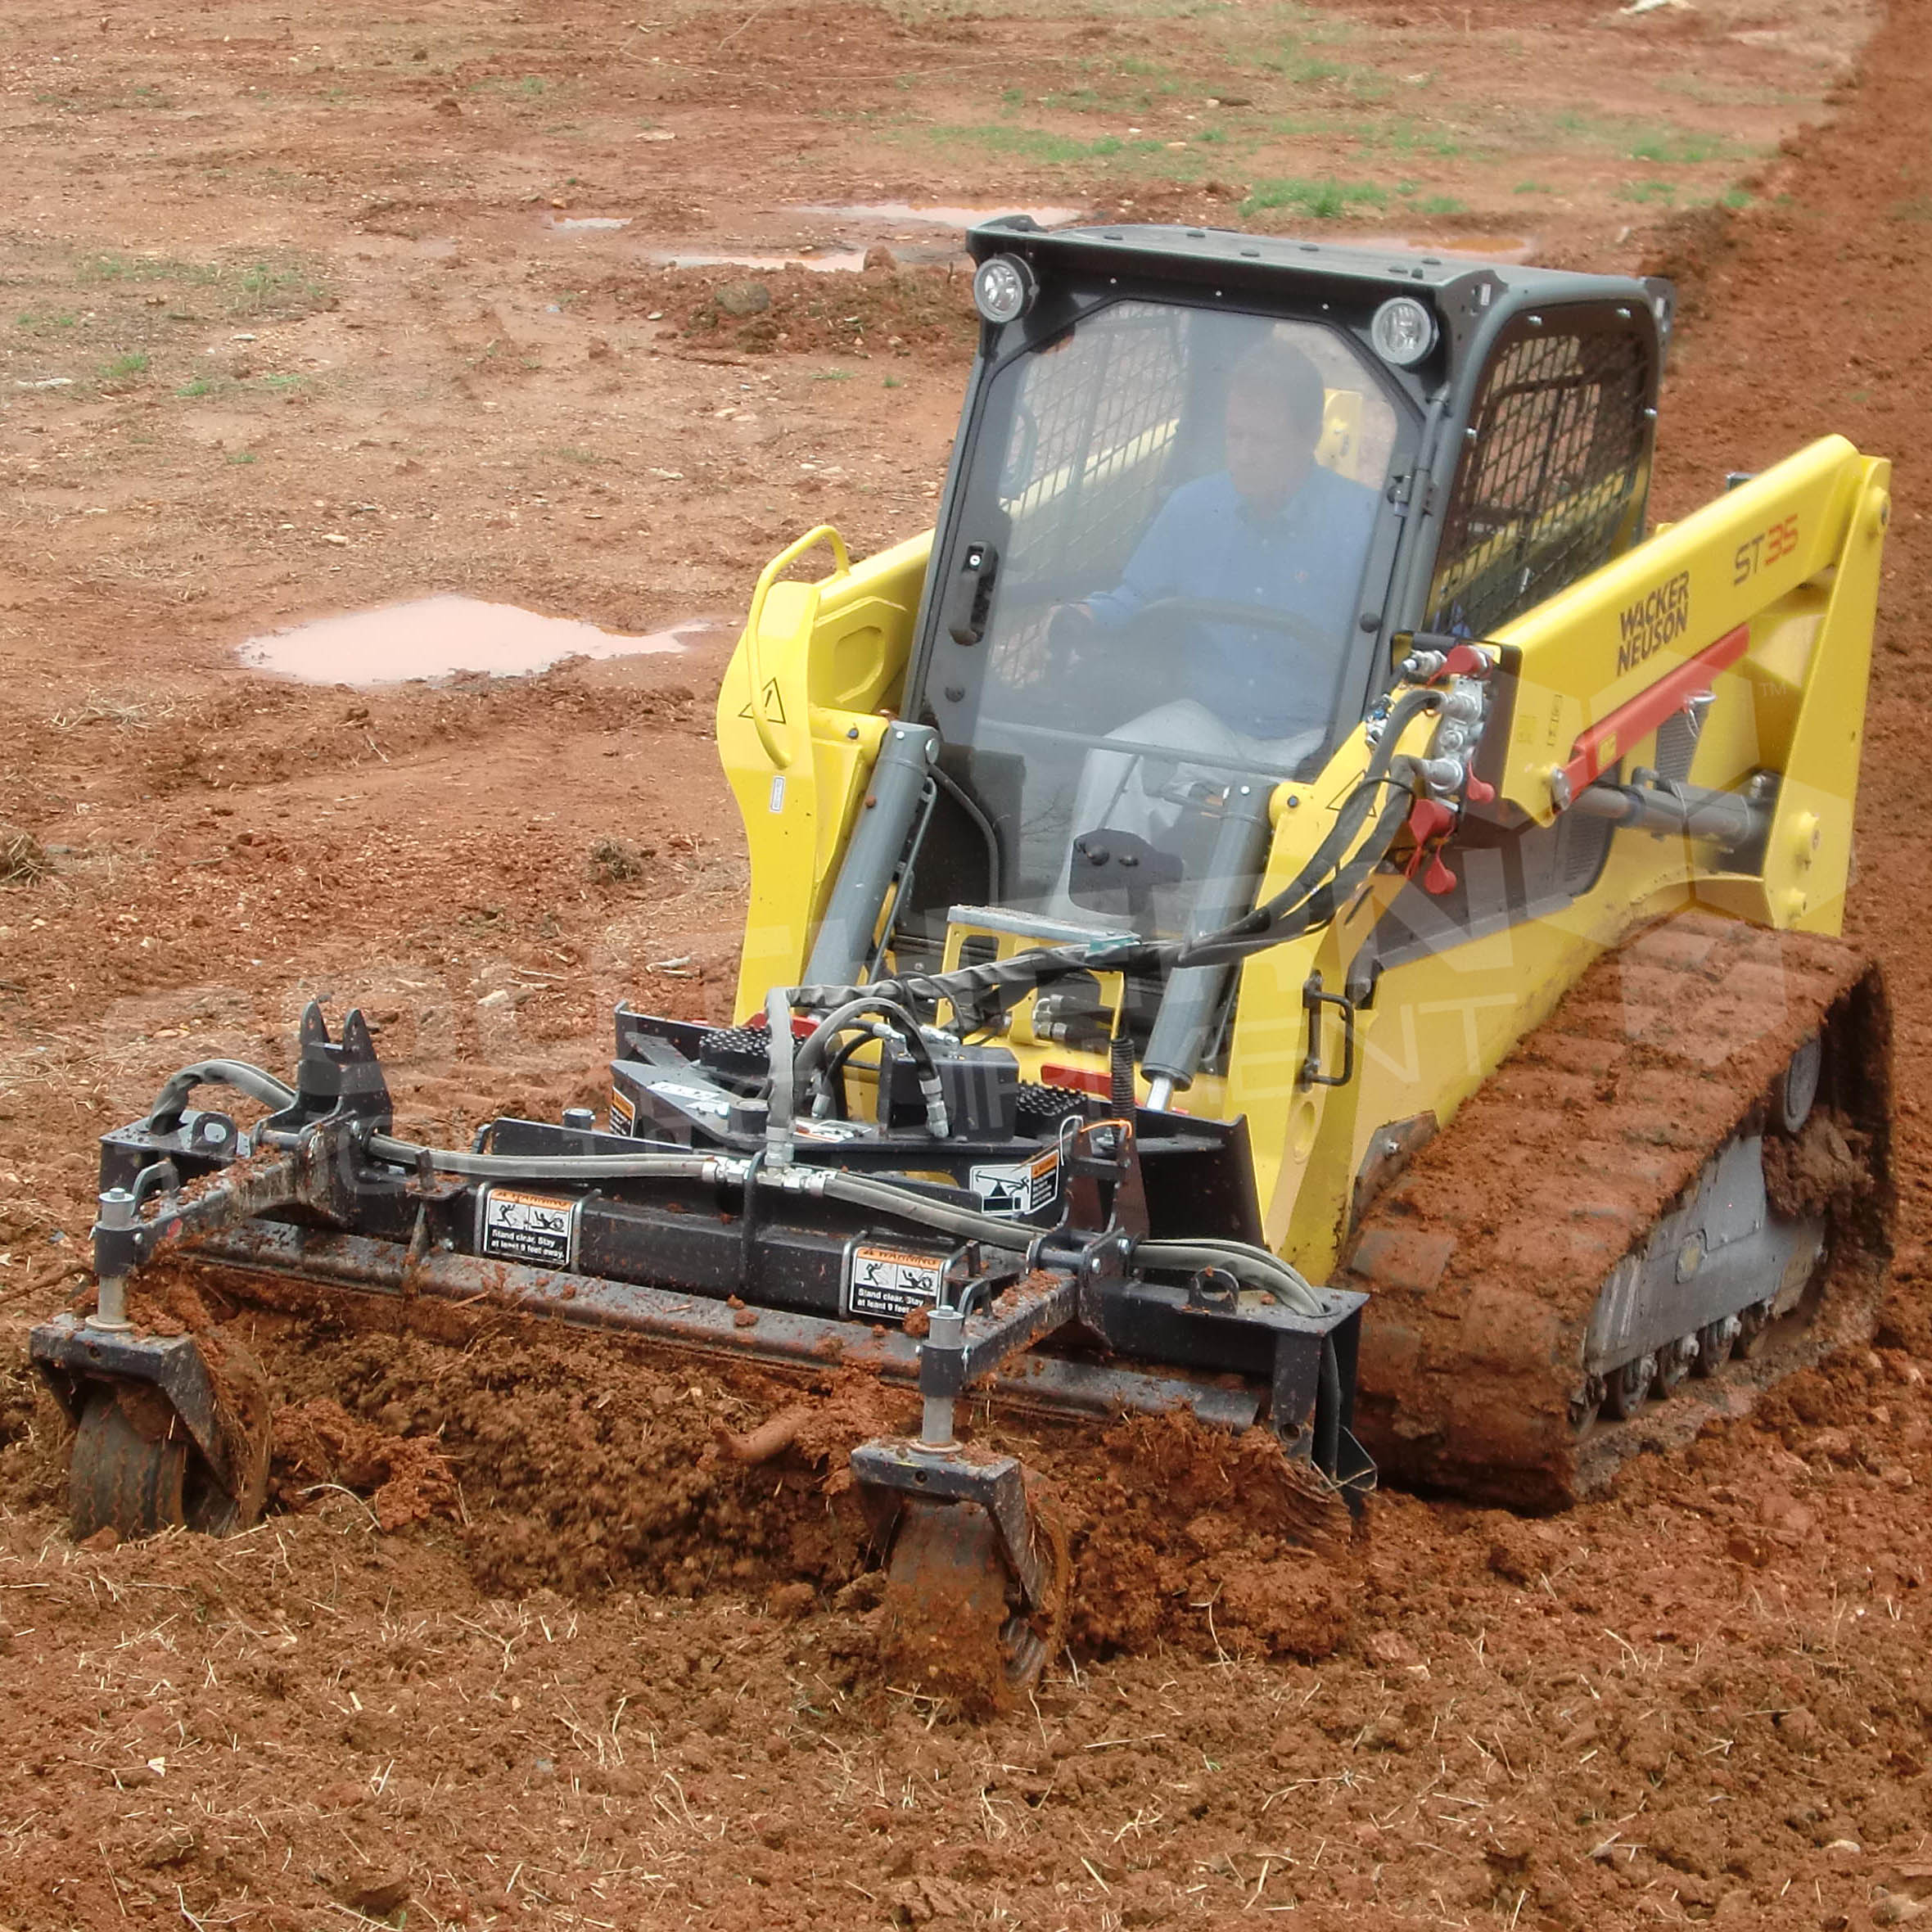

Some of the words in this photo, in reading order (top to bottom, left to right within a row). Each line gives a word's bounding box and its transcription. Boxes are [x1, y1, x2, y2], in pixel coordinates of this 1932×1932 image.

[1733, 513, 1799, 586] ST35
[1620, 571, 1690, 640] WACKER
[1617, 602, 1690, 677] NEUSON
[492, 1229, 514, 1240] Stand
[516, 1234, 536, 1244] clear.
[537, 1237, 555, 1248] Stay
[879, 1251, 937, 1265] WARNING
[858, 1288, 882, 1299] Stand
[883, 1293, 904, 1303] clear.
[905, 1296, 924, 1307] Stay
